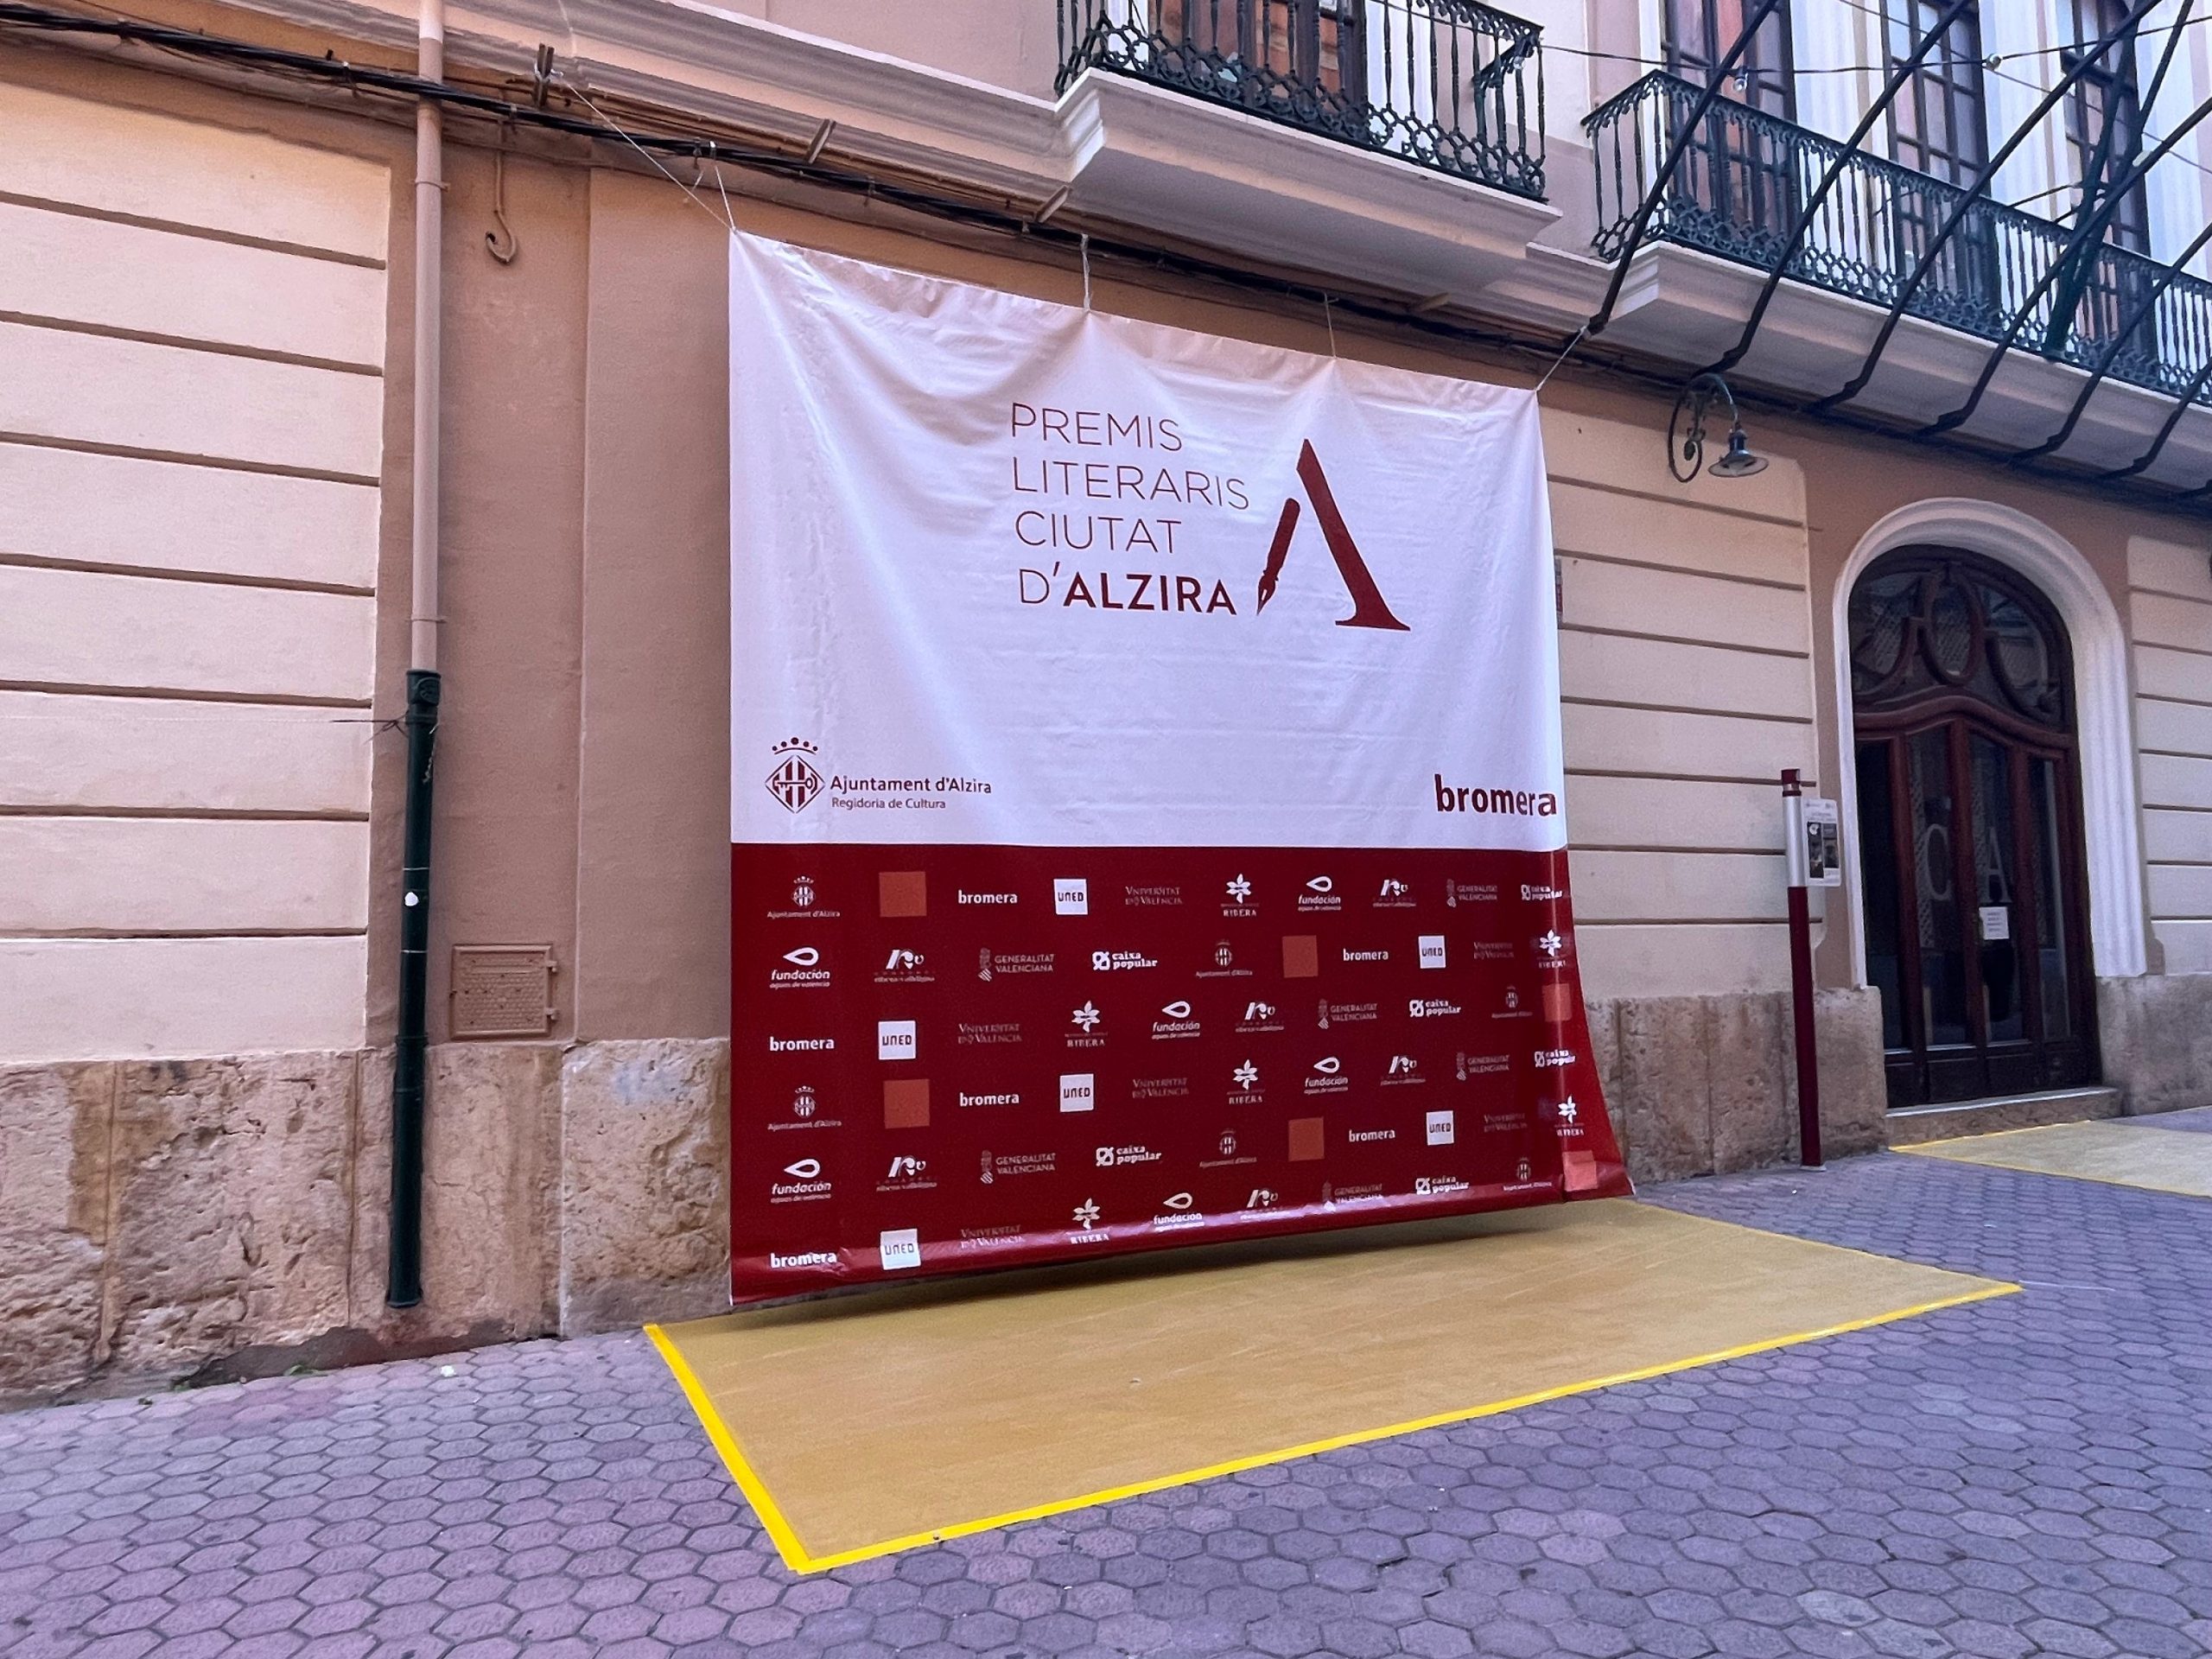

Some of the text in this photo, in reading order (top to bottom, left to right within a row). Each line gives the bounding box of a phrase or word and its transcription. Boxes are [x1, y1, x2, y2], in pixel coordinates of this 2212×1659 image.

[1012, 403, 1182, 451] PREMIS
[1014, 457, 1249, 510] LITERARIS
[1015, 512, 1181, 553] CIUTAT
[830, 776, 992, 794] Ajuntament d'Alzira
[1434, 773, 1557, 817] bromera
[832, 798, 946, 810] Regidoria de Cultura
[958, 890, 1018, 905] bromera
[995, 954, 1054, 963] GENERALITAT
[1112, 951, 1141, 960] caixa
[1344, 949, 1389, 962] bromera
[996, 964, 1053, 973] VALENCIANA
[1112, 959, 1158, 969] popular
[1426, 1007, 1460, 1017] popular
[770, 1037, 835, 1051] bromera
[960, 1092, 1020, 1107] bromera
[1349, 1128, 1395, 1142] bromera
[1116, 1146, 1145, 1154] caixa
[996, 1154, 1055, 1166] GENERALITAT
[1117, 1152, 1161, 1164] popular
[998, 1164, 1054, 1174] VALENCIANA
[770, 1253, 837, 1268] bromera
